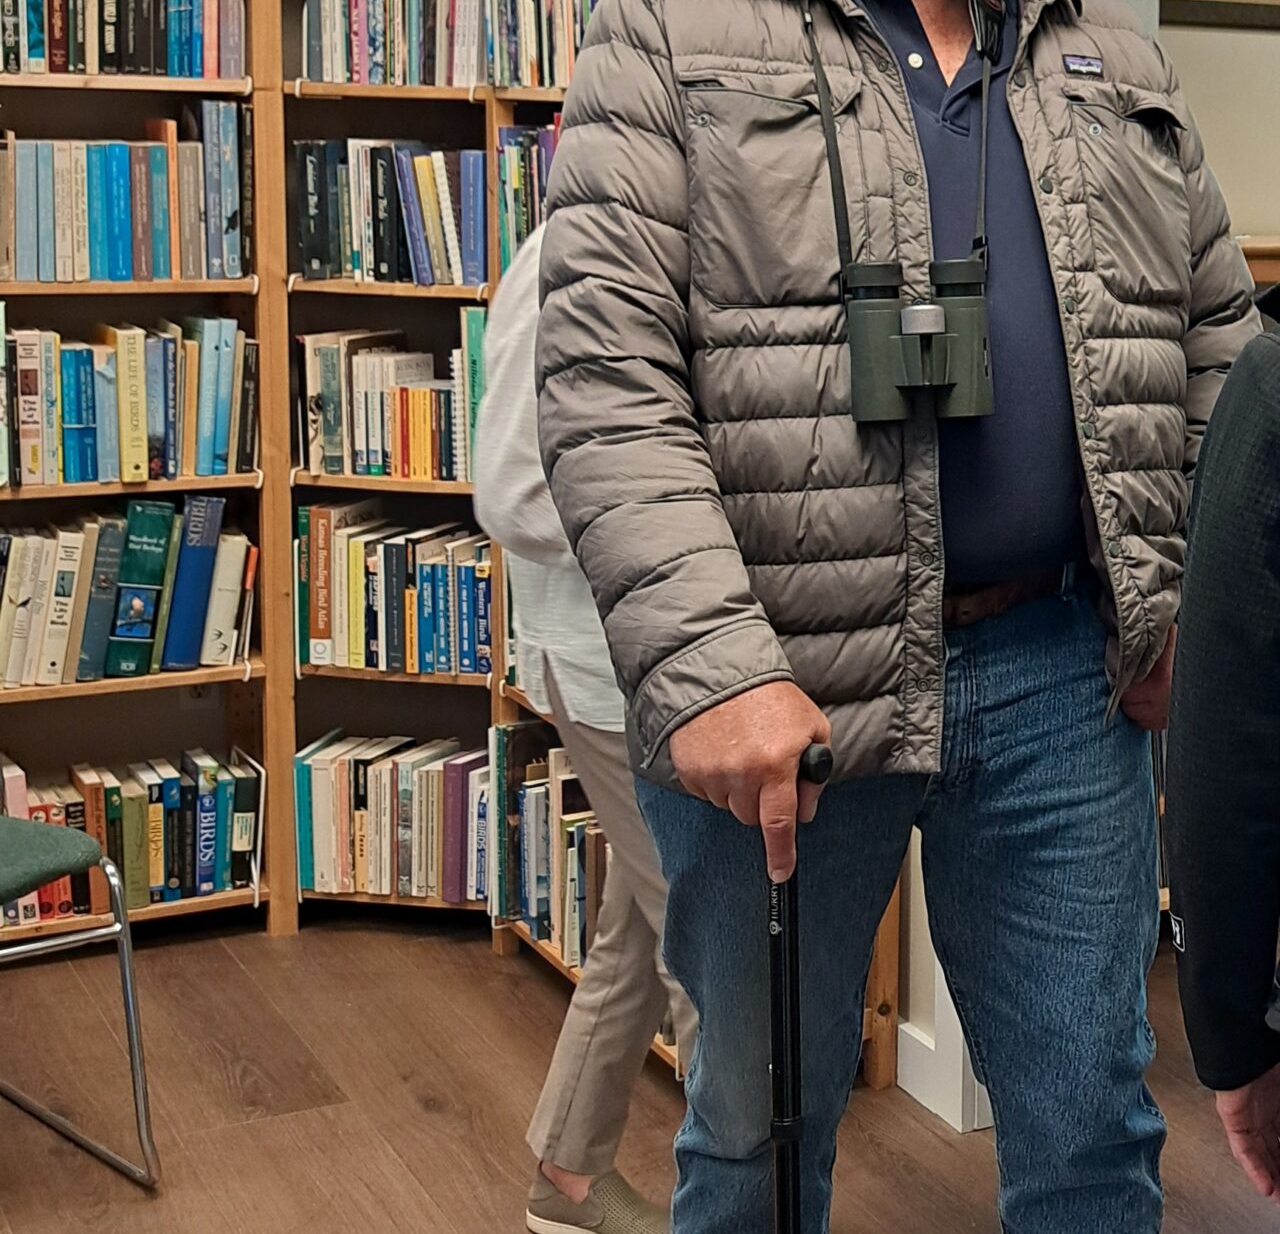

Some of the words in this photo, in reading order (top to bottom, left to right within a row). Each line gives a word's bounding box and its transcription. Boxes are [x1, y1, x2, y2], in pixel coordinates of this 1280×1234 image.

[127, 336, 136, 356] THE
[128, 358, 138, 380] LIFE
[129, 385, 138, 396] OF
[130, 401, 140, 432] BIRDS
[187, 499, 208, 547] BIRDS
[317, 518, 327, 549] Kansas
[316, 549, 328, 587] Breeding
[317, 588, 328, 608] Bird
[478, 581, 486, 616] Western
[317, 608, 328, 630] Atlas
[478, 618, 487, 641] Birds
[150, 819, 162, 858] BIRDS
[200, 811, 216, 862] BIRDS
[477, 820, 486, 850] BIRDS
